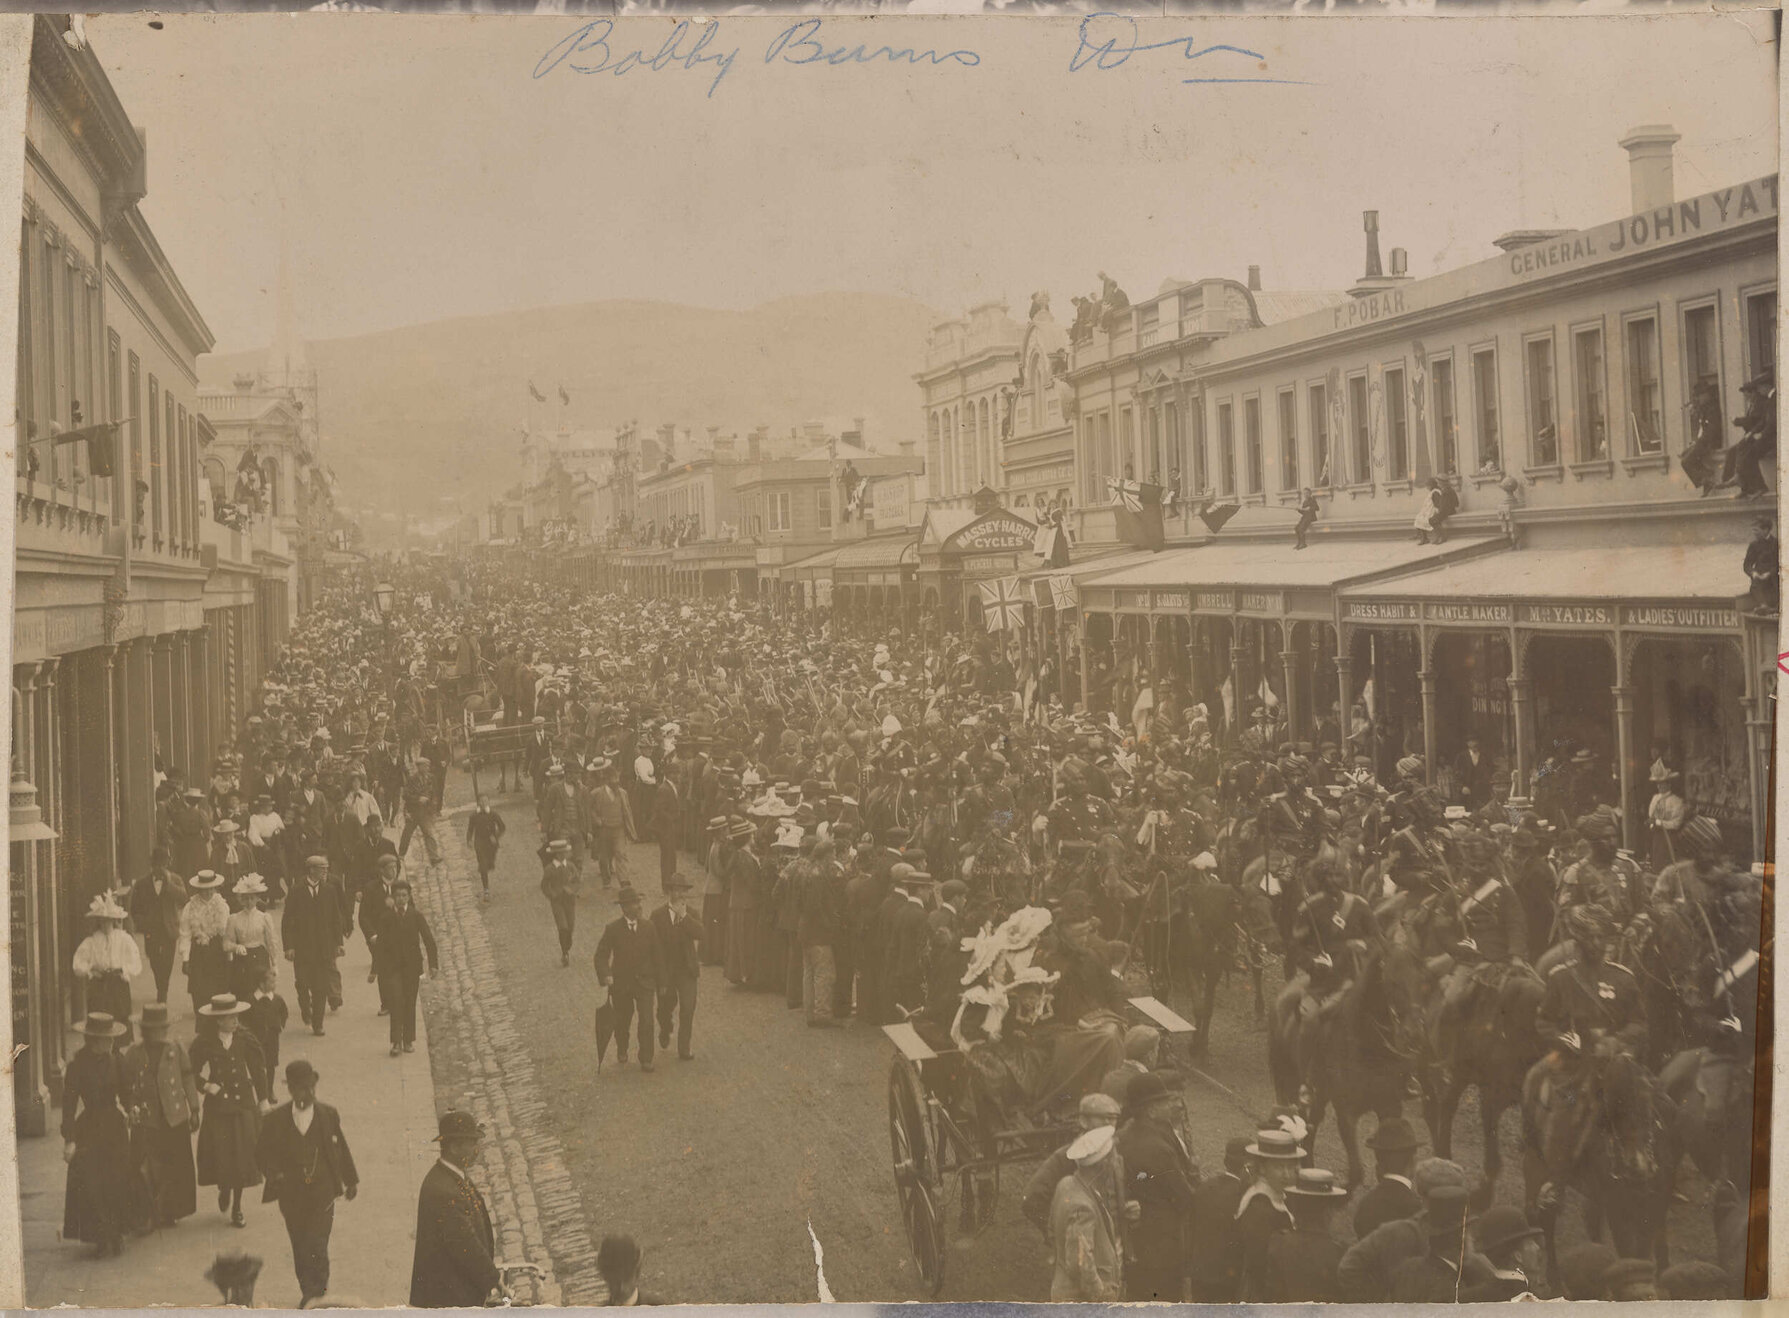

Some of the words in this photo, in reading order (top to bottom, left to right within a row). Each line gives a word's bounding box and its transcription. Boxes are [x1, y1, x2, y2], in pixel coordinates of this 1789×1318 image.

[533, 19, 739, 98] Bobby
[1510, 236, 1597, 276] GENERAL
[1609, 199, 1701, 252] JOHN
[974, 536, 1024, 548] CYCLES
[1350, 603, 1377, 617] DRESS
[1380, 604, 1404, 618] HABIT
[1409, 605, 1416, 618] &
[1628, 609, 1636, 624] &
[1677, 608, 1738, 626] OUTFITTER
